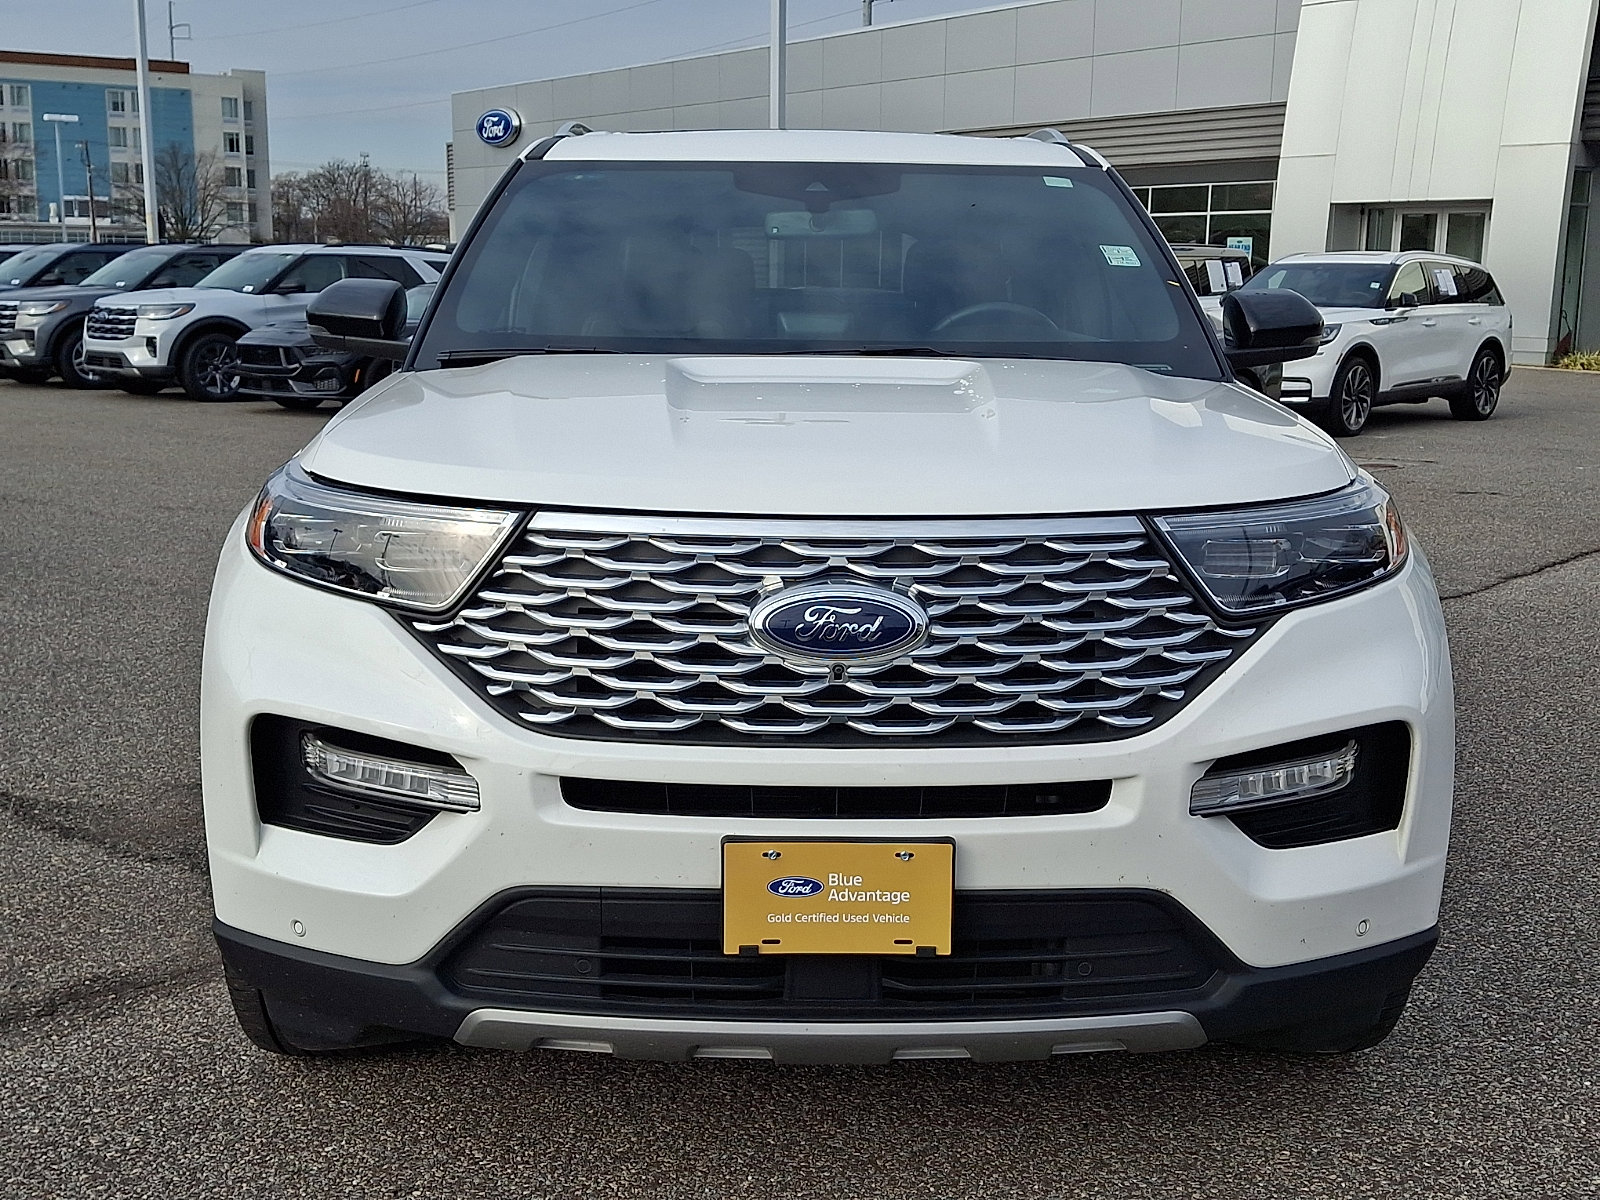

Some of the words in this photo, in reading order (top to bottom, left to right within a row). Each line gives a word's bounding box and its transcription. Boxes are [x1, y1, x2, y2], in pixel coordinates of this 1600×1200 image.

[482, 116, 505, 138] Ford
[795, 605, 884, 642] Ford
[778, 879, 813, 894] Ford
[828, 873, 863, 886] Blue
[828, 888, 910, 904] Advantage
[767, 913, 792, 923] Gold
[794, 912, 839, 923] Certified
[842, 913, 869, 923] Used
[872, 913, 910, 923] Vehicle
